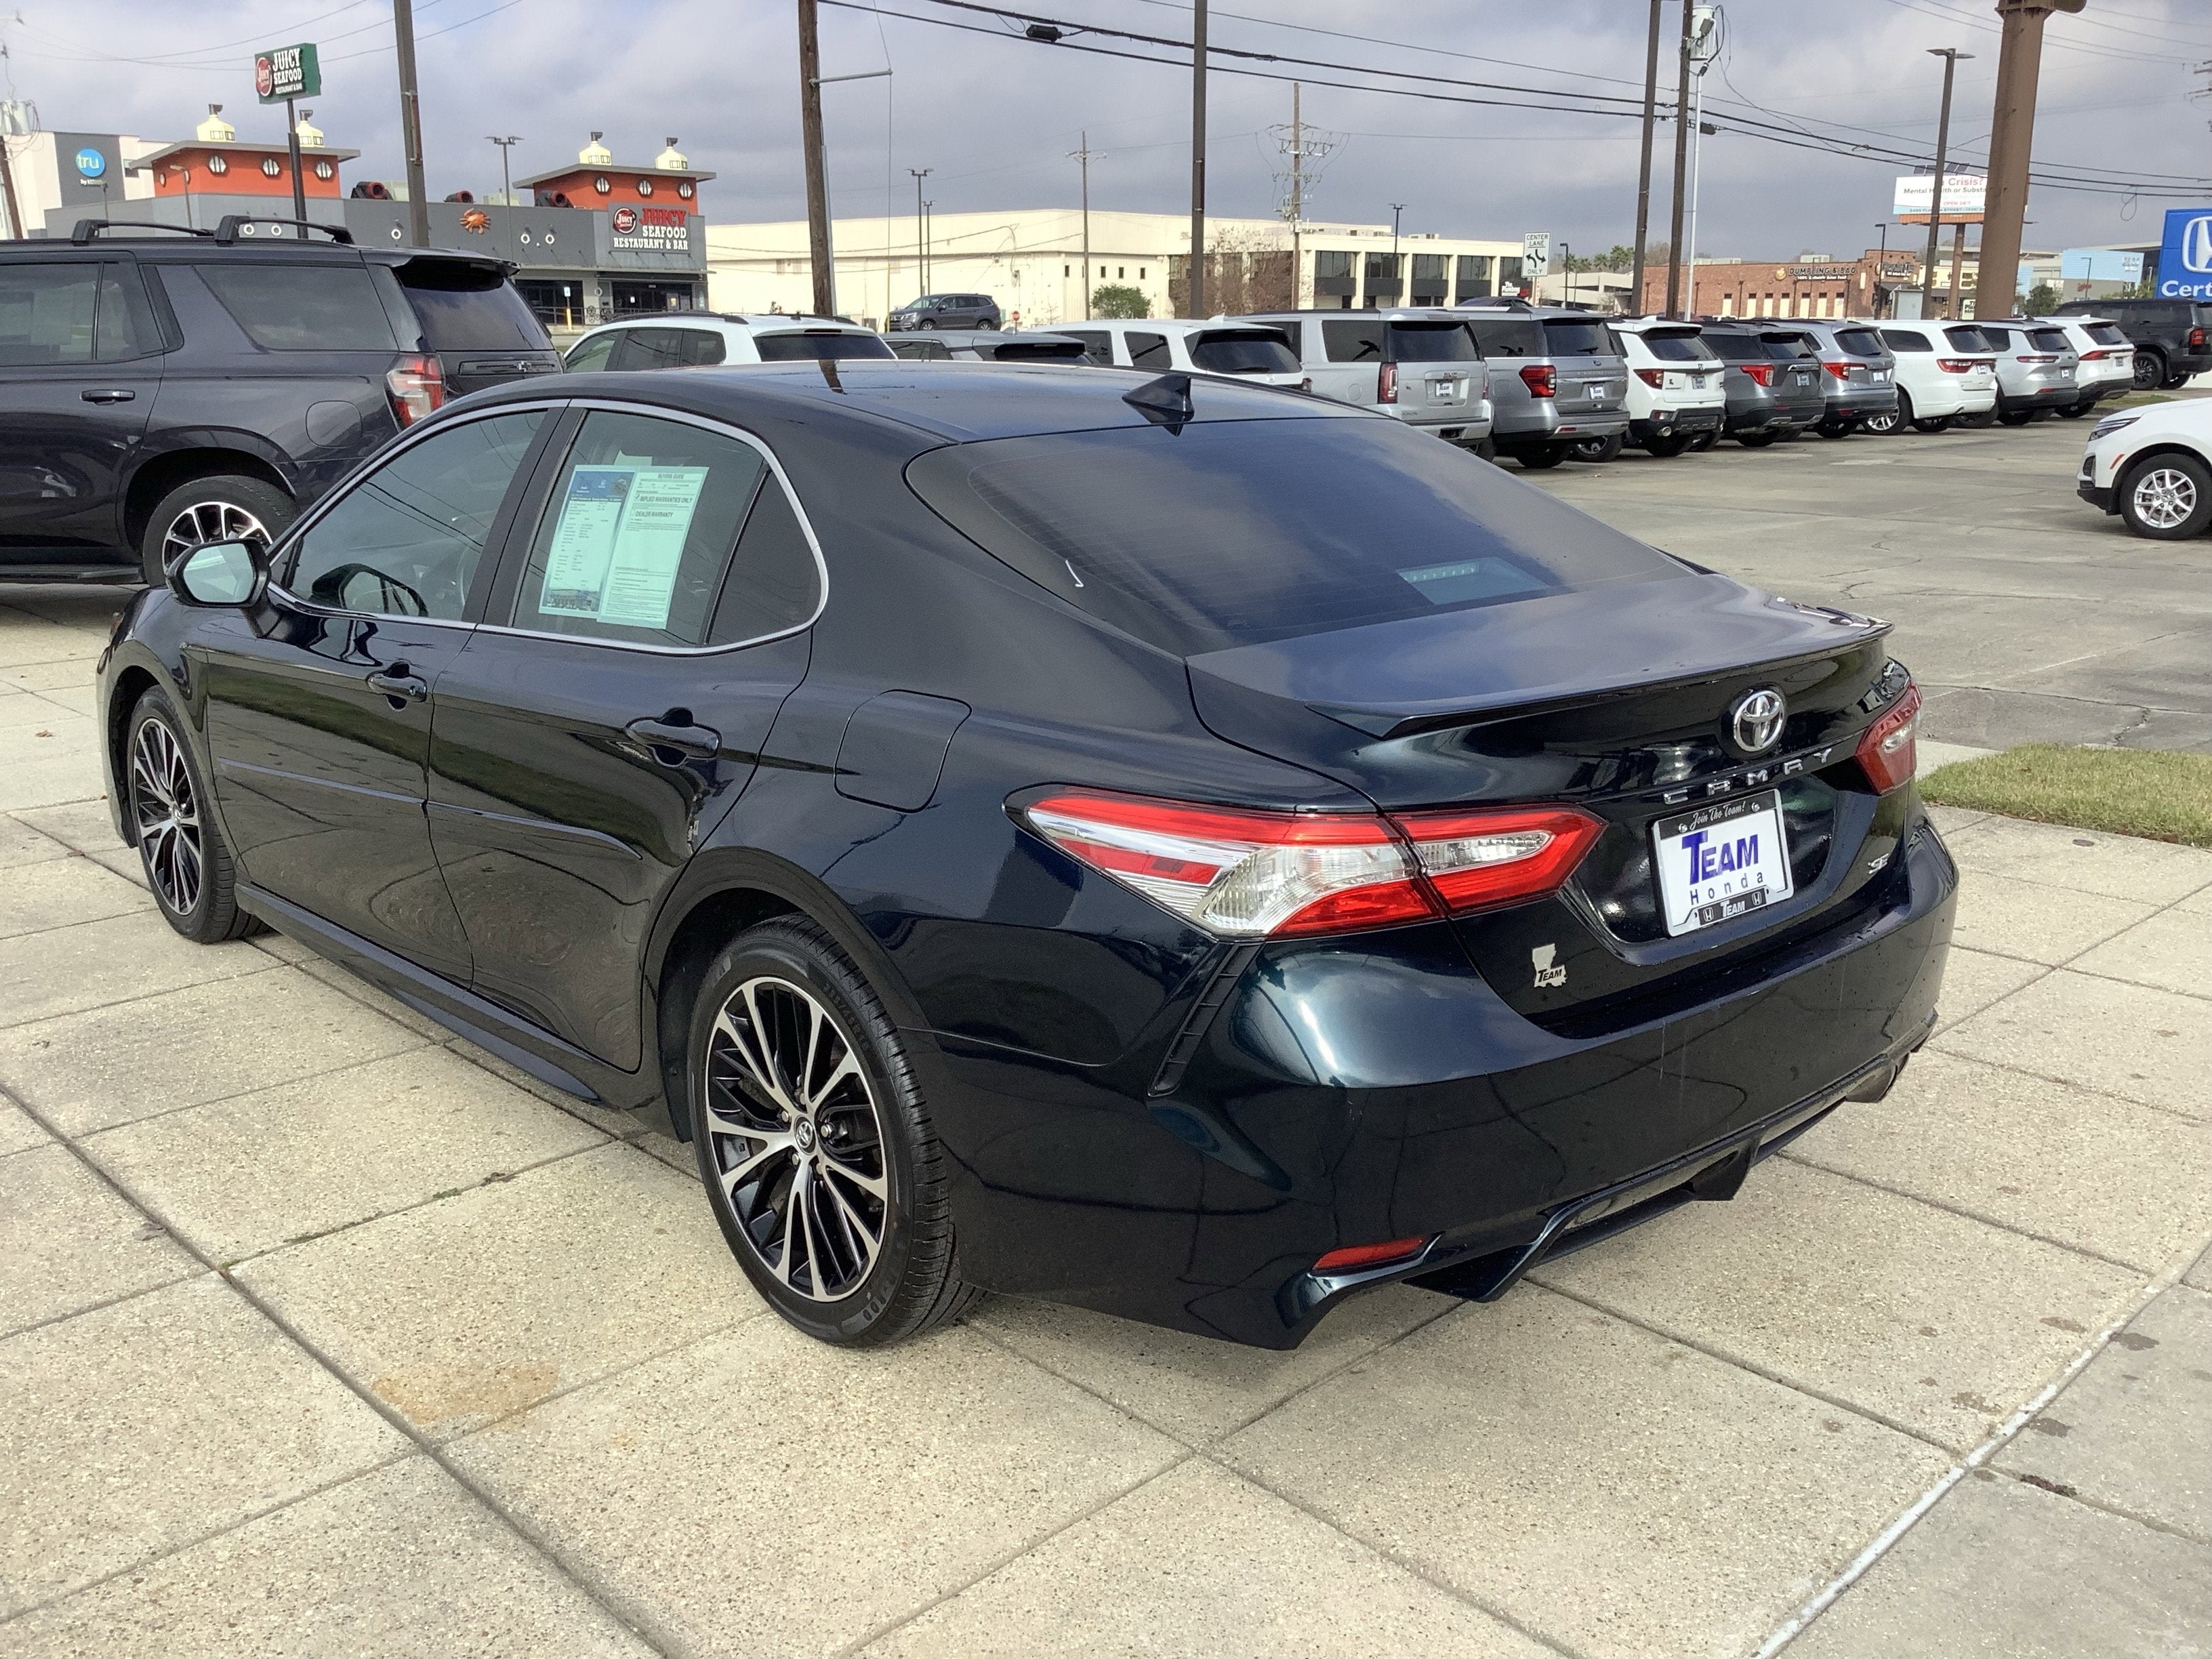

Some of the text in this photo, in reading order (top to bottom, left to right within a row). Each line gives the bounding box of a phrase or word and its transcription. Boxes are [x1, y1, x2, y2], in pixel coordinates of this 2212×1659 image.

[273, 48, 300, 71] JUICY
[273, 68, 302, 85] SEAFOOD
[76, 154, 100, 169] tru
[1948, 177, 1984, 186] Crisis?
[639, 208, 687, 226] JUICY
[642, 226, 687, 239] SEAFOOD
[613, 237, 688, 250] RESTAURANT & BAR
[1840, 266, 1856, 274] BAO
[1664, 748, 1832, 805] CAMRY
[1689, 812, 1708, 831] Join
[1708, 806, 1723, 821] The
[1681, 830, 1759, 885] TEAM
[1868, 853, 1889, 874] SE
[1721, 899, 1745, 918] TEAM
[1538, 968, 1562, 983] TEAM
